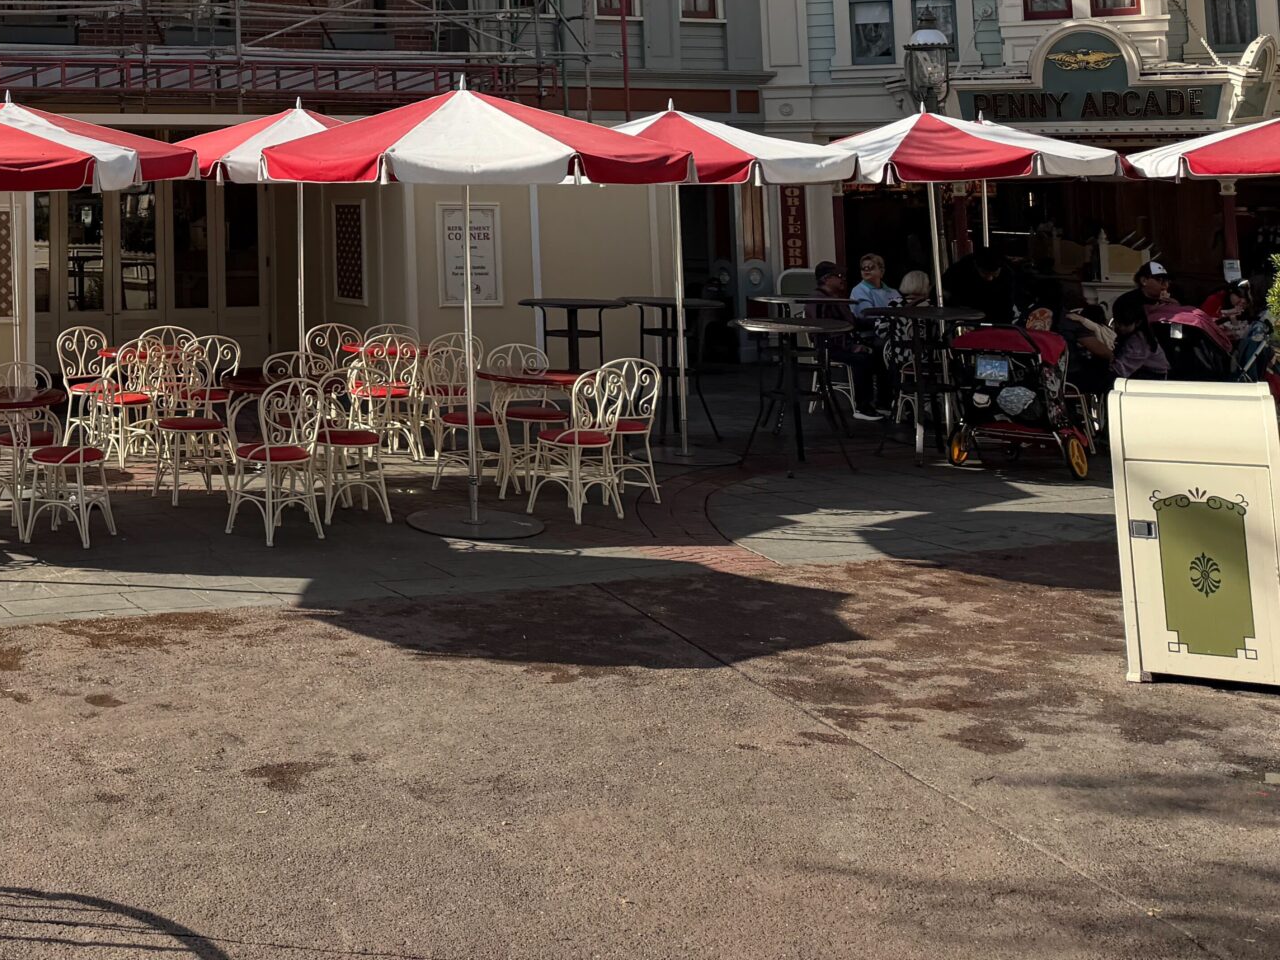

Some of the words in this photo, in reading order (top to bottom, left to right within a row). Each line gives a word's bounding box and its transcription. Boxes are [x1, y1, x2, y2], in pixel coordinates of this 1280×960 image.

[973, 91, 1070, 119] PENNY
[1080, 88, 1205, 119] ARCADE
[784, 187, 801, 233] OBILE
[447, 232, 491, 240] CONER
